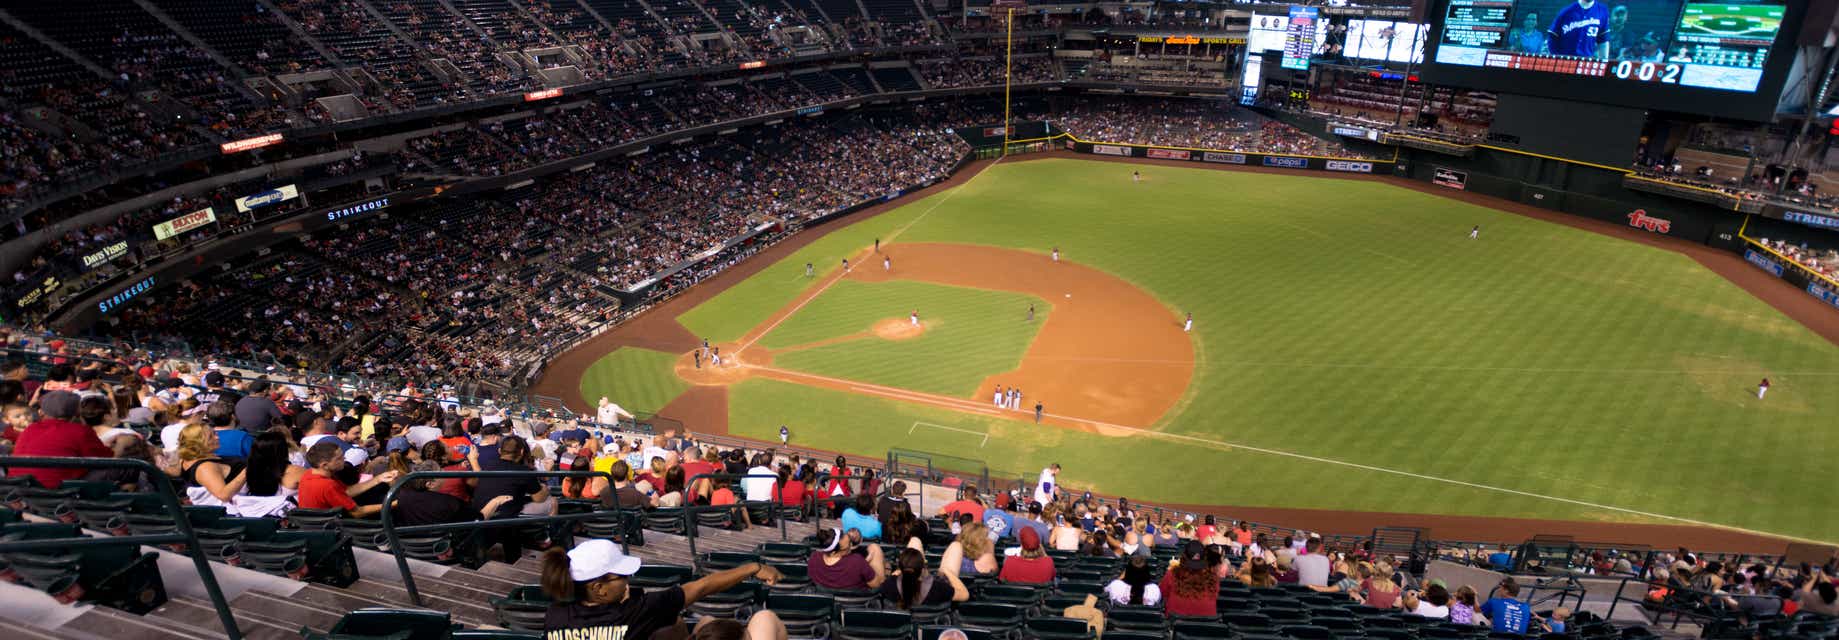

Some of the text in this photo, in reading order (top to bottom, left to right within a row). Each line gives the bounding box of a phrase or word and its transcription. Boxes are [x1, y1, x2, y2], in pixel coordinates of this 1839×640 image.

[1616, 60, 1632, 79] 0
[1639, 62, 1655, 81] 0
[1661, 63, 1680, 83] 2
[1207, 153, 1234, 161] CHASE
[1327, 160, 1372, 171] GEICO
[327, 198, 389, 220] STRIKEOUT
[172, 210, 208, 230] SEXTON
[98, 275, 155, 313] STRIKEOUT
